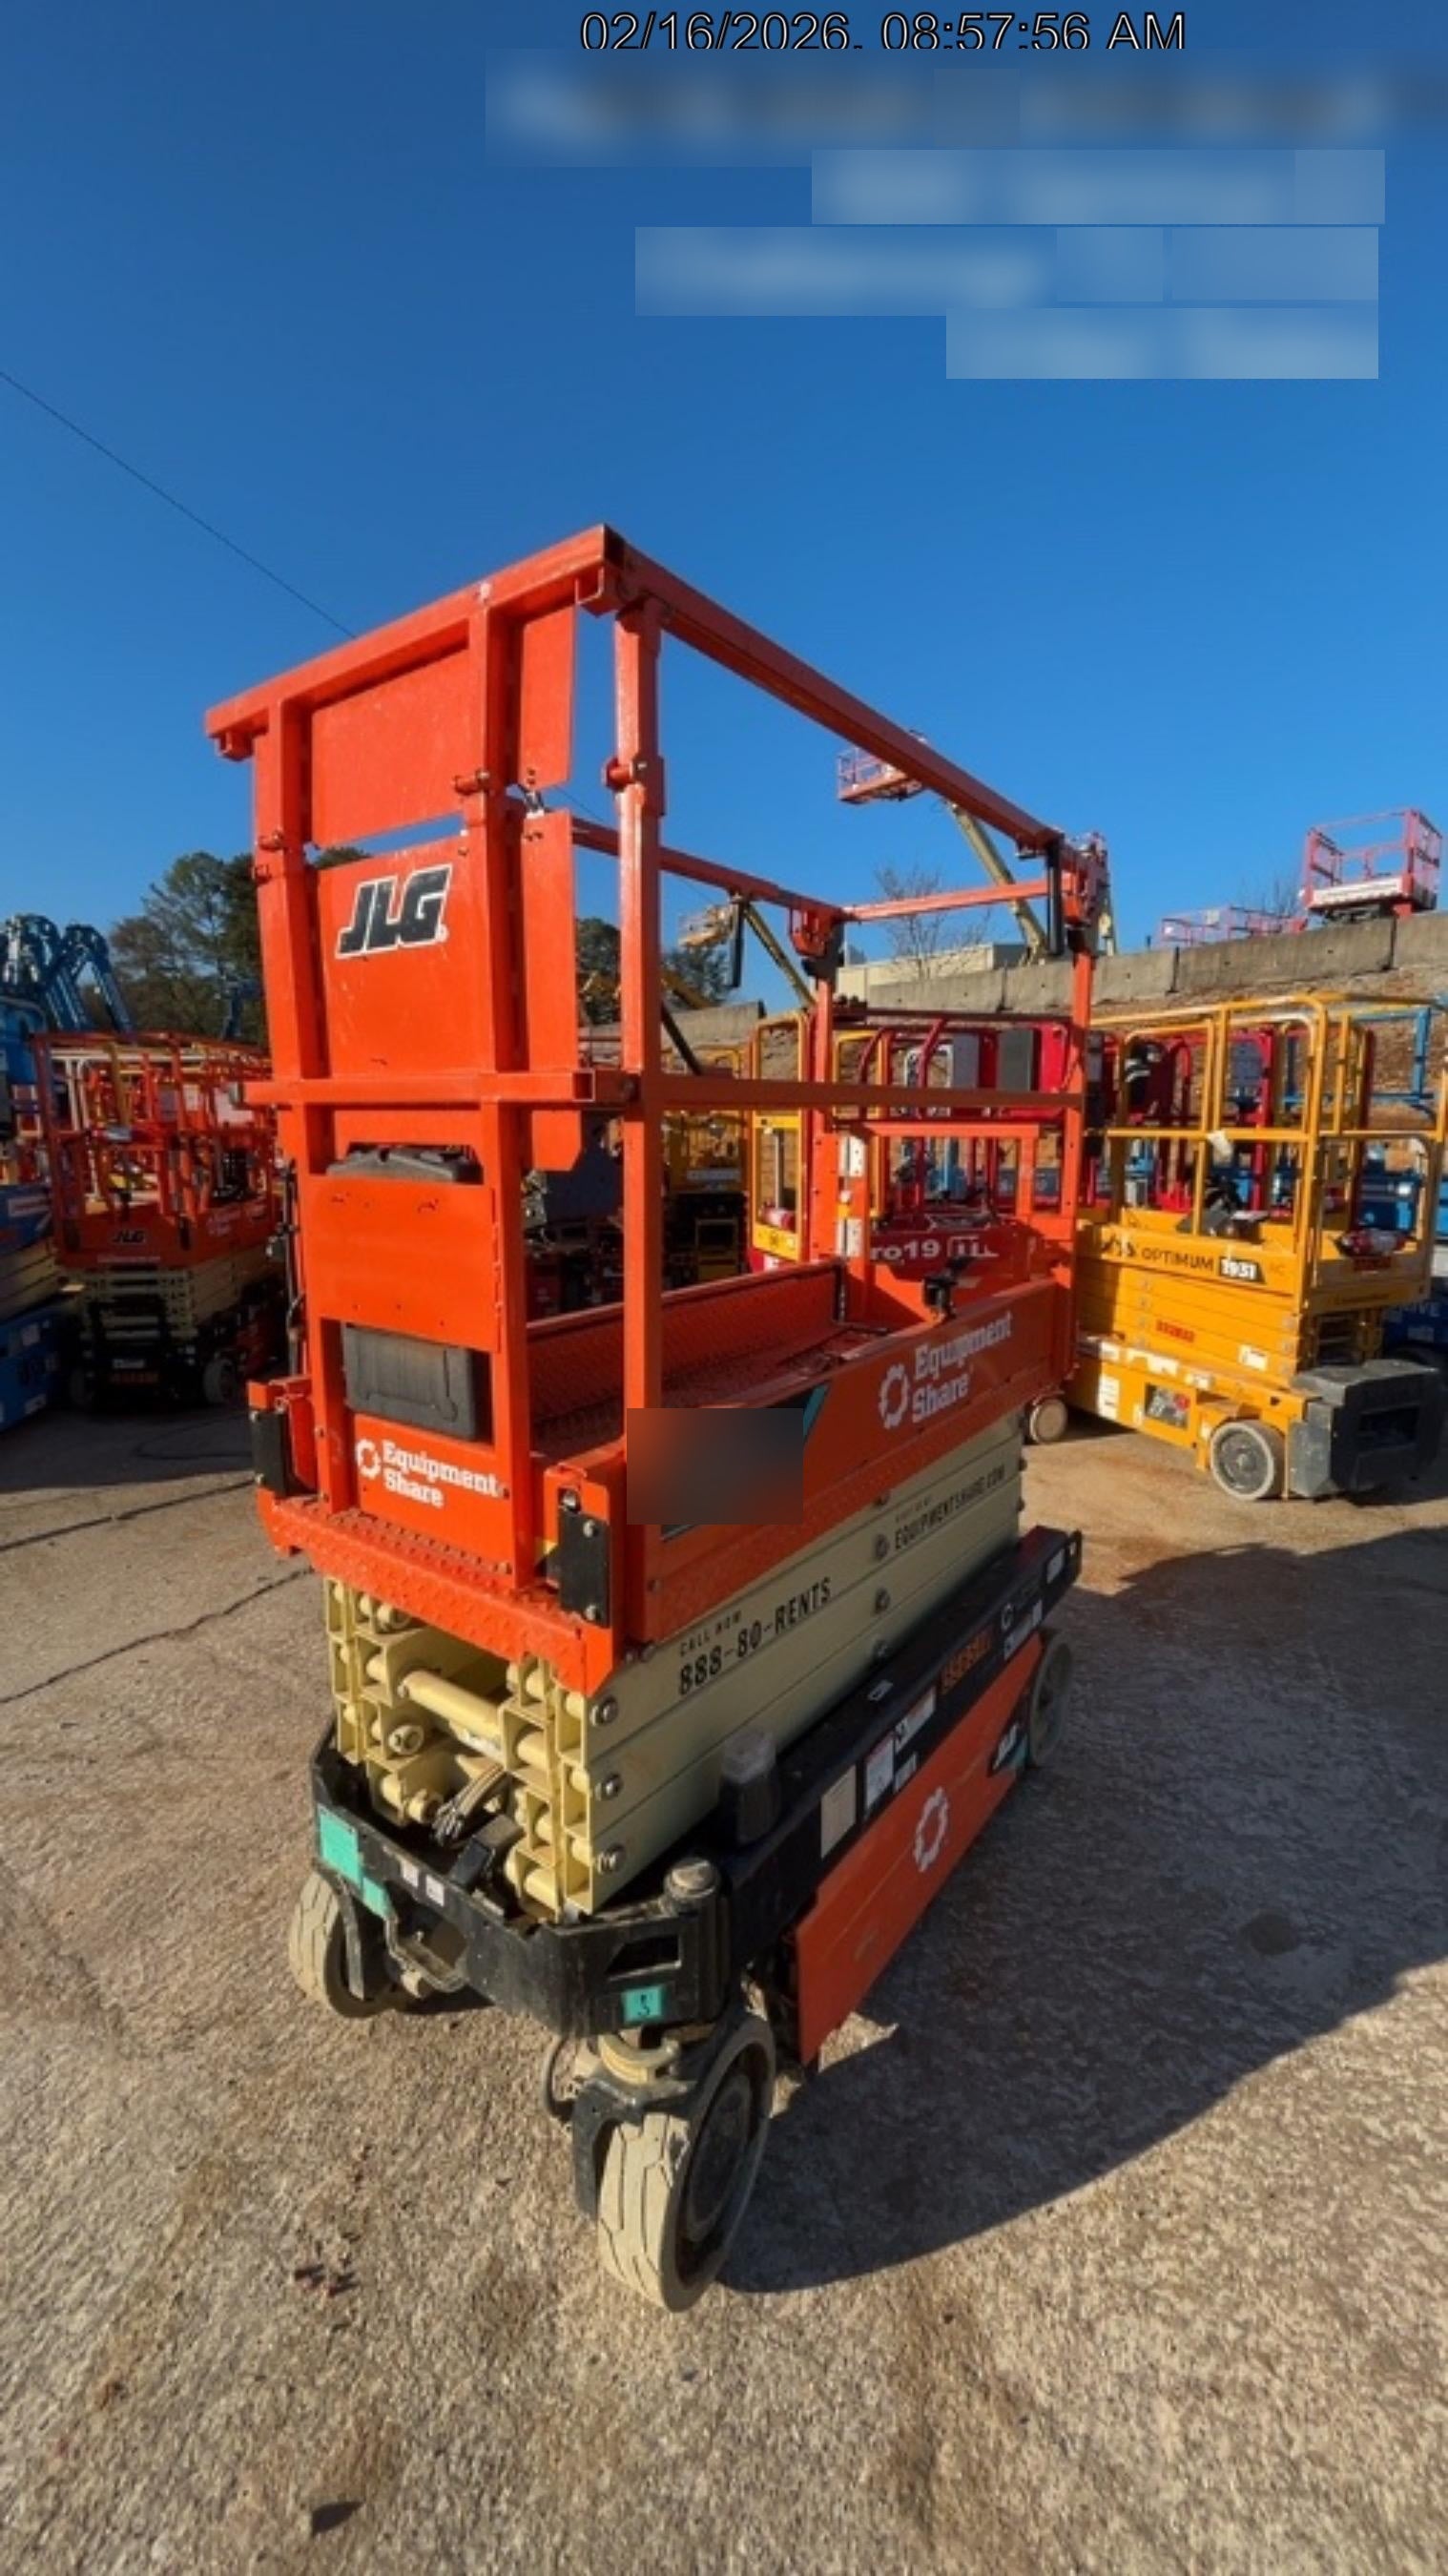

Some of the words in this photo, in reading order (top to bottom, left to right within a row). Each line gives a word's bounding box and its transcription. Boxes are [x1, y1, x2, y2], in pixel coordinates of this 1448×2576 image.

[334, 862, 452, 960] JLG
[1141, 1246, 1213, 1271] OPTIMUM
[915, 1310, 1013, 1381] Equipment
[912, 1373, 970, 1424] Share
[382, 1440, 501, 1498] Equipment
[383, 1467, 445, 1509] Share
[679, 1576, 832, 1696] 888-80-RENTS
[680, 1628, 711, 1657] CALL
